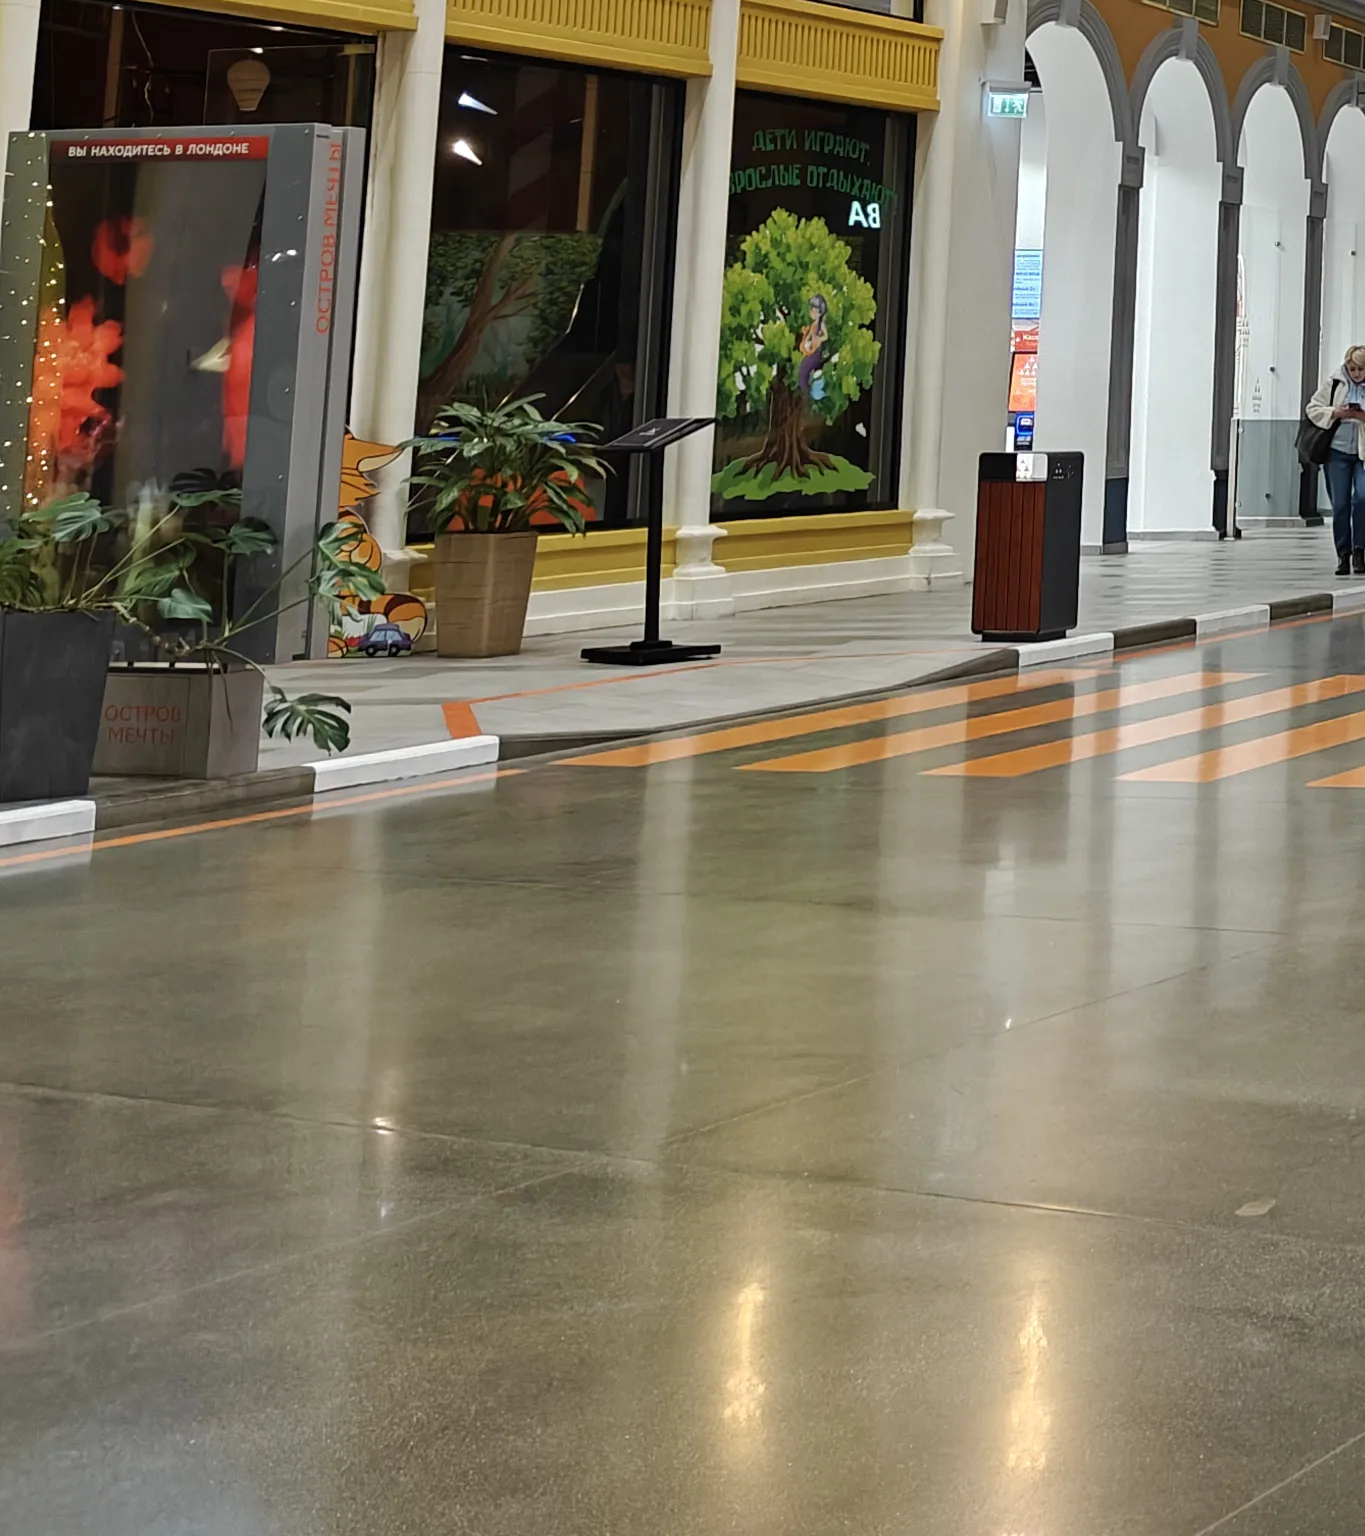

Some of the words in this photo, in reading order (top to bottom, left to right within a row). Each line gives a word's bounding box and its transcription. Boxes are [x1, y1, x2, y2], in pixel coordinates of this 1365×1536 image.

[752, 129, 797, 151] ДЕТИ
[68, 146, 87, 157] ВЫ
[91, 144, 171, 158] НАХОДИТЕСЬ
[175, 144, 183, 155] В
[187, 143, 249, 156] ЛОНДОНЕ
[729, 164, 801, 195] РОСЛЫЕ
[315, 234, 335, 334] ОСТРОВ
[104, 704, 182, 723] ОСТРОВ
[108, 726, 174, 745] МЕЧТЫ
